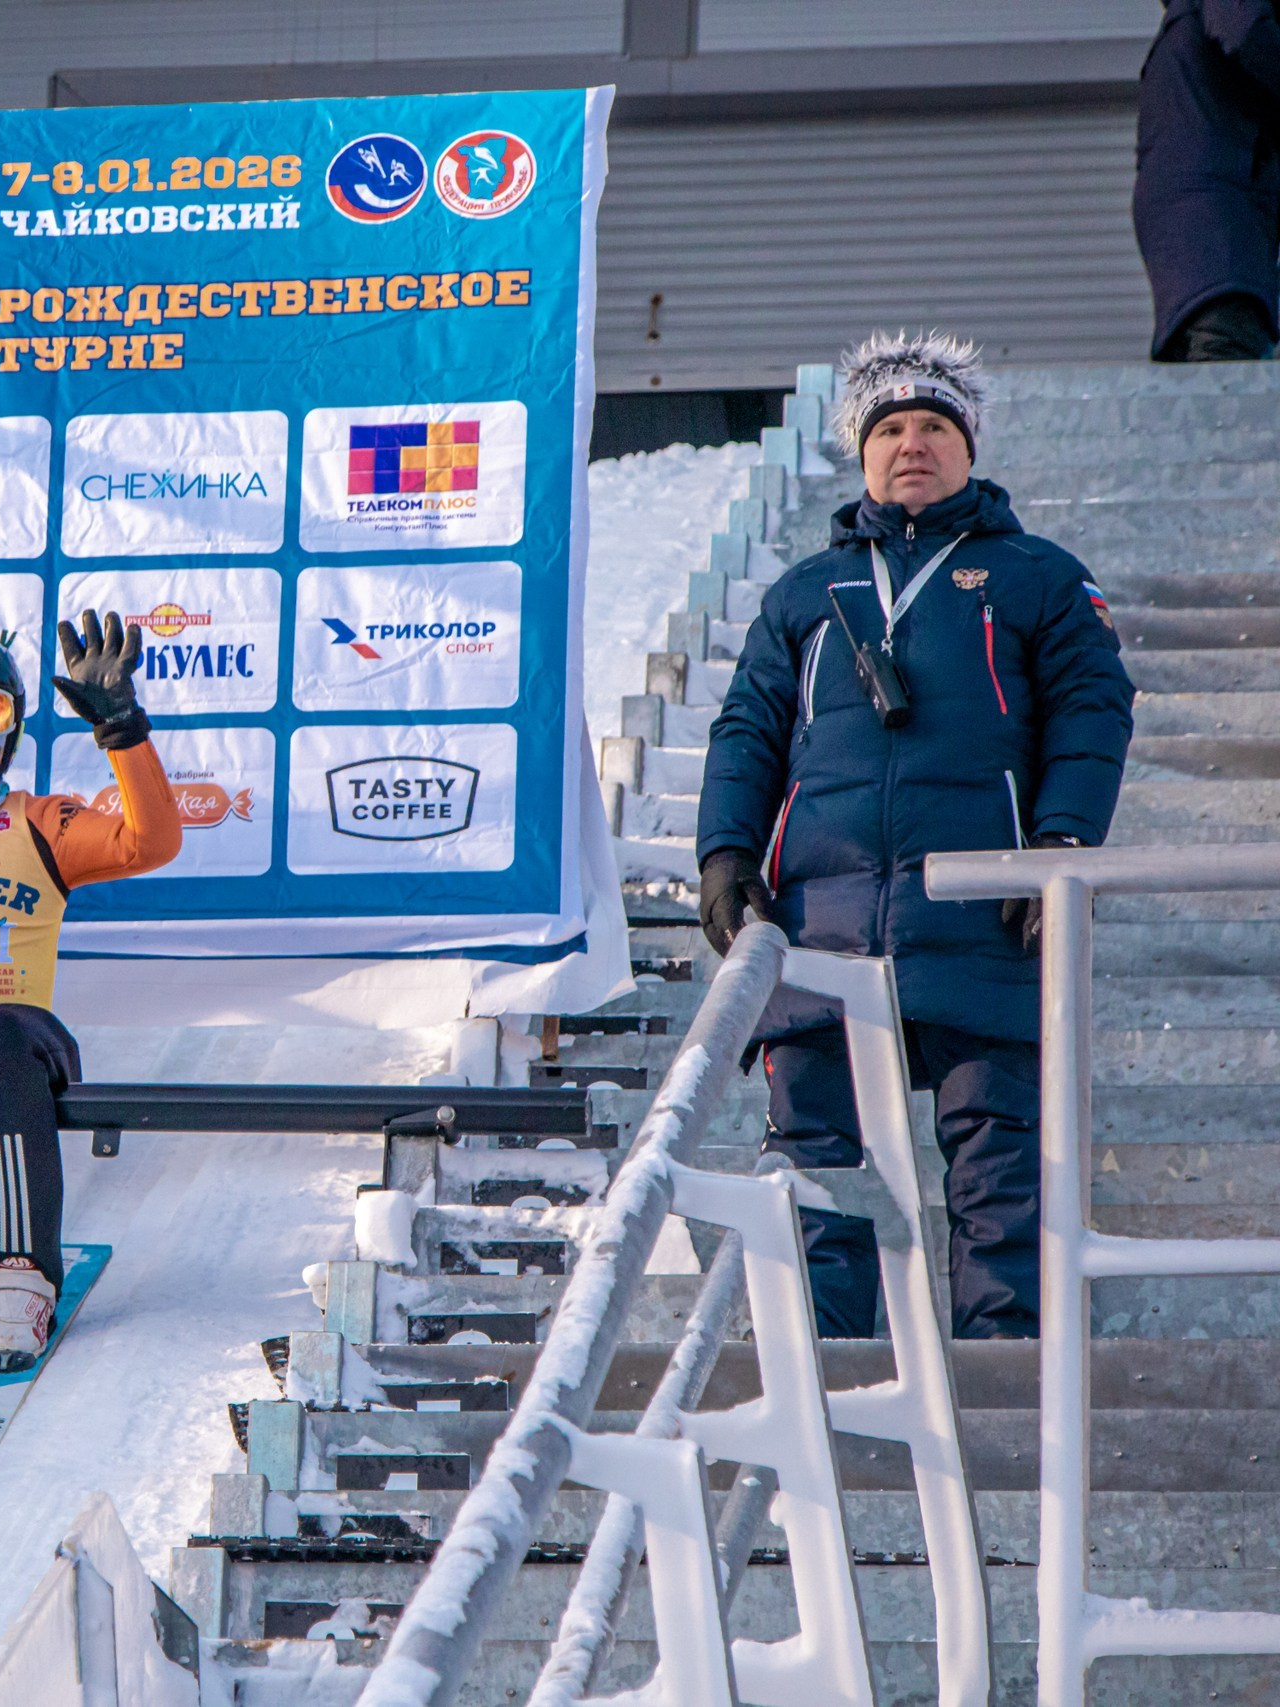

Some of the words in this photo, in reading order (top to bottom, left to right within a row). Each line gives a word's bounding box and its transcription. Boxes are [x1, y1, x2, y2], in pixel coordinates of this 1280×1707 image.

[1, 154, 303, 196] 7-8.01.2026
[0, 194, 302, 237] ЧАЙКОВСКИЙ
[81, 469, 267, 502] СНЕЖИНКА
[347, 497, 476, 512] ТЕЛЕКОМПЛЮС
[442, 512, 477, 520] системы
[126, 615, 166, 625] РУССКИЙ
[168, 614, 209, 625] ПРОДУКТ
[365, 621, 496, 640] ТРИКОЛОР
[446, 642, 495, 654] СПОРТ
[174, 770, 215, 780] фабрика
[349, 778, 457, 799] TASTY
[352, 803, 452, 820] COFFEE
